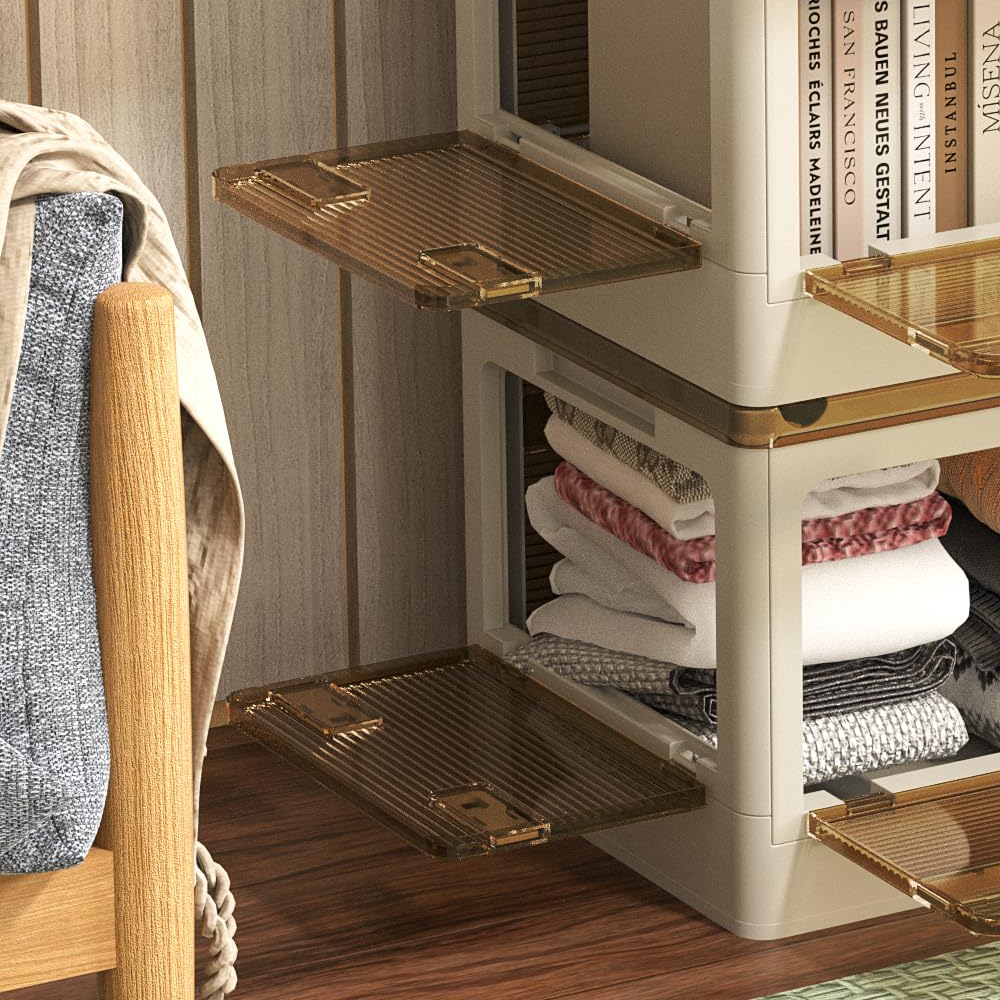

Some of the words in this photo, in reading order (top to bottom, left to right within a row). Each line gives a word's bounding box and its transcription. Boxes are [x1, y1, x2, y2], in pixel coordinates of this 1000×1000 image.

[843, 10, 855, 56] SAN
[874, 19, 889, 85] BAUEN
[913, 4, 931, 98] LIVING
[808, 80, 824, 150] ÉCLAIRS
[843, 68, 856, 205] FRANCISCO
[875, 92, 890, 157] NEUES
[944, 52, 957, 174] INSTANBUL
[809, 158, 822, 255] MADELEINE
[875, 162, 890, 241] GESTALT
[913, 124, 931, 220] INTENT
